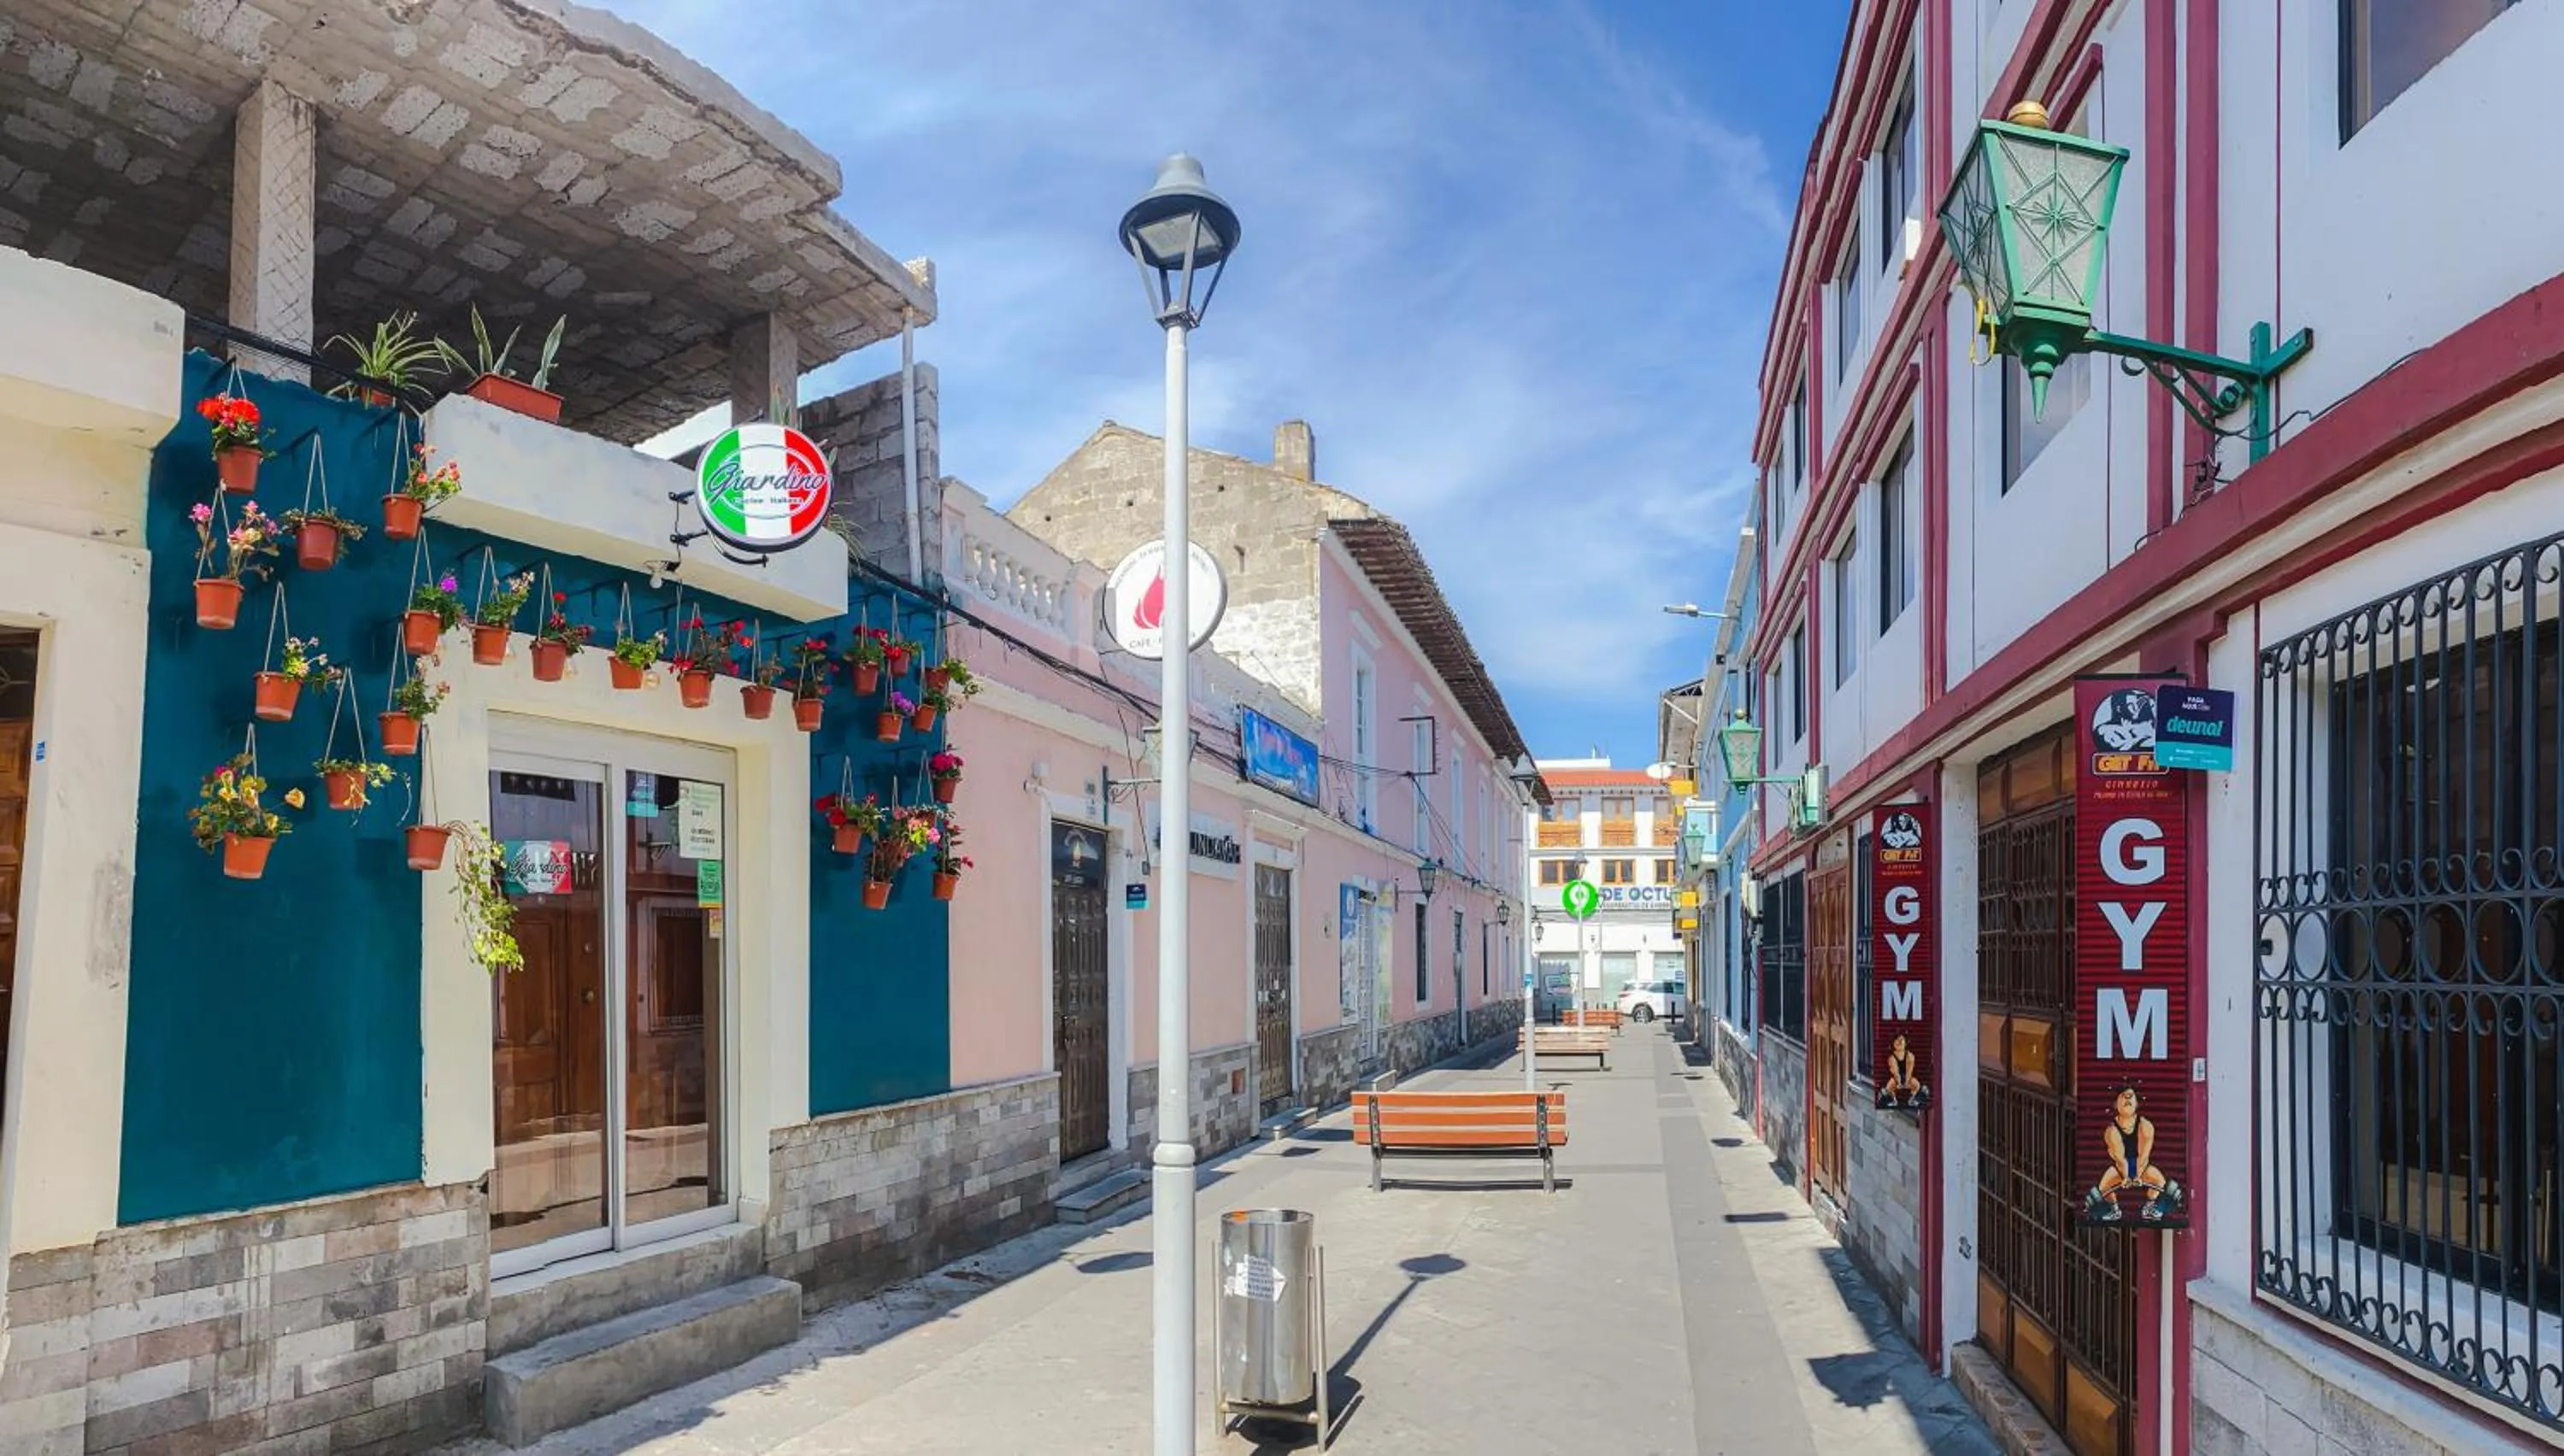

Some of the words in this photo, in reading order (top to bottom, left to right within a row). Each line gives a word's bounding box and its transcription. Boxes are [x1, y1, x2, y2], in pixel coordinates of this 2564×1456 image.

[708, 462, 826, 504] Giardino
[1602, 887, 1624, 901] DE
[1882, 885, 1922, 1021] GYM
[2096, 818, 2168, 1060] GYM
